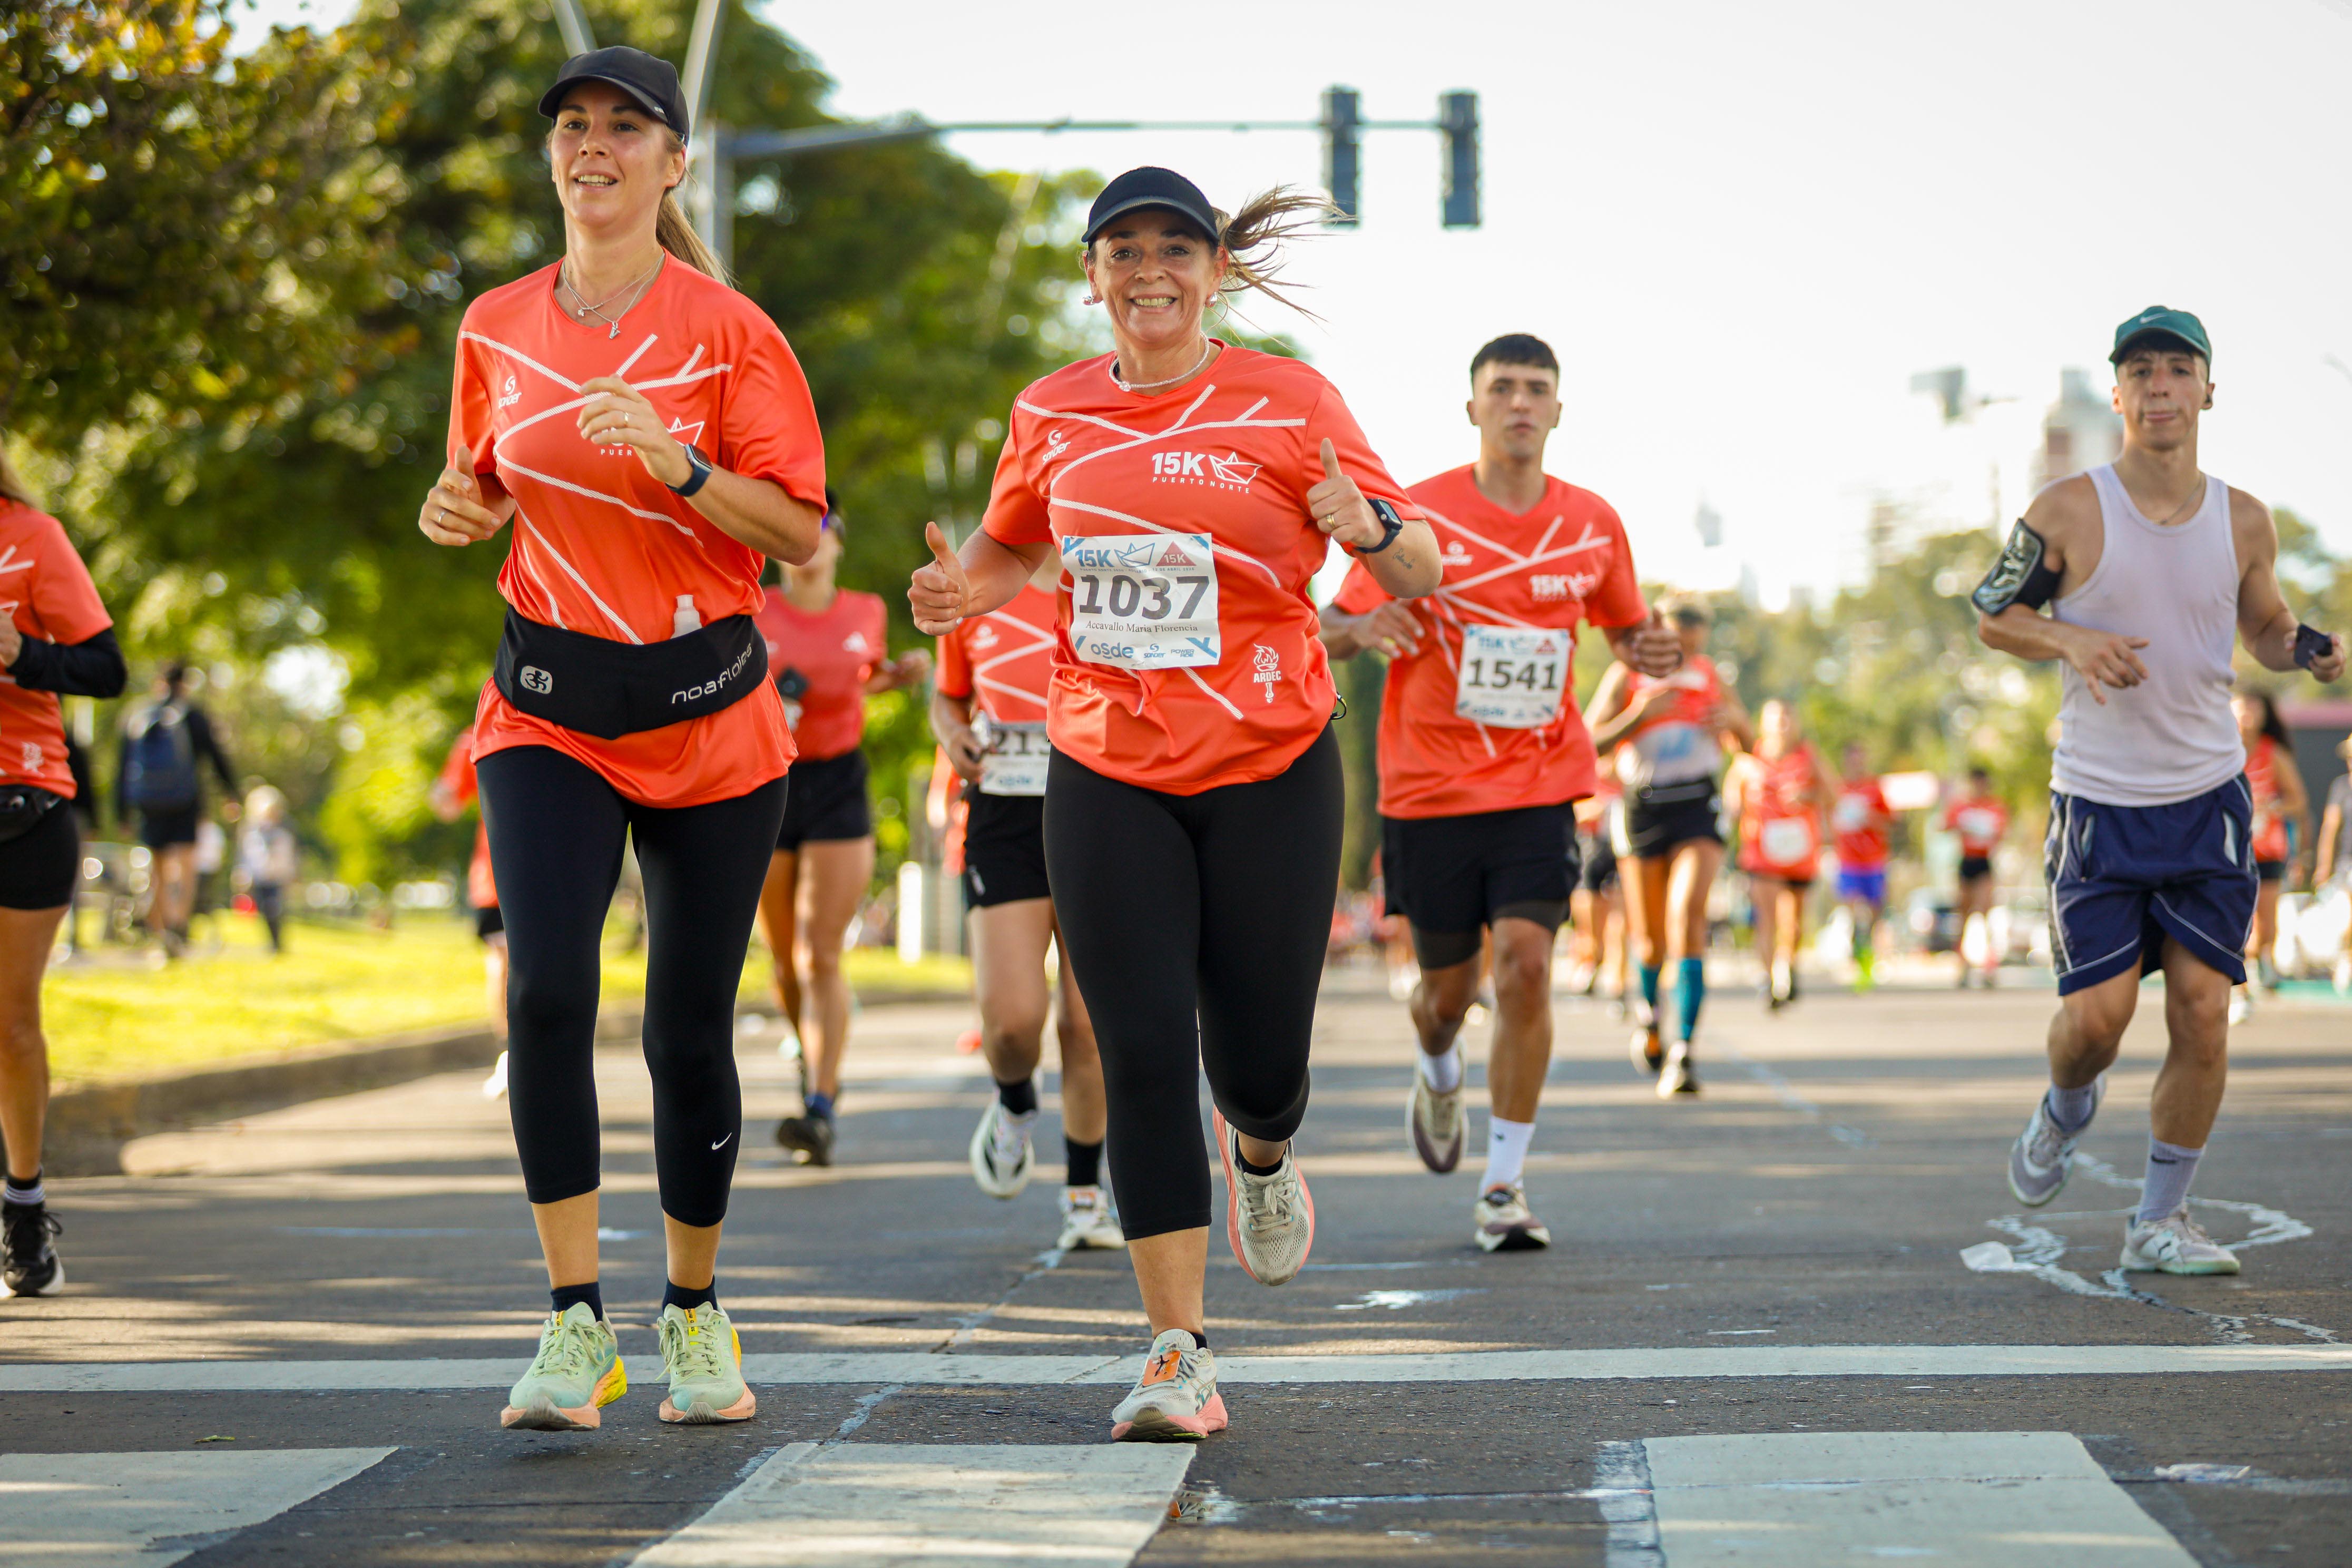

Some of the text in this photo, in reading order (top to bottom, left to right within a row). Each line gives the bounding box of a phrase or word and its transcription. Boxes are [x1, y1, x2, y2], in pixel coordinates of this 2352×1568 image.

[1152, 452, 1206, 476] 15K
[1152, 477, 1249, 494] PUERTO NORTE
[1075, 549, 1115, 567] 15K
[1164, 554, 1186, 563] 15K
[1079, 574, 1210, 620] 1037
[1086, 621, 1123, 631] Accavallo
[1126, 623, 1152, 632] Maria
[1091, 642, 1134, 658] osde
[672, 643, 752, 704] noaflojes
[1253, 671, 1281, 683] ARDEC
[1467, 658, 1557, 690] 1541
